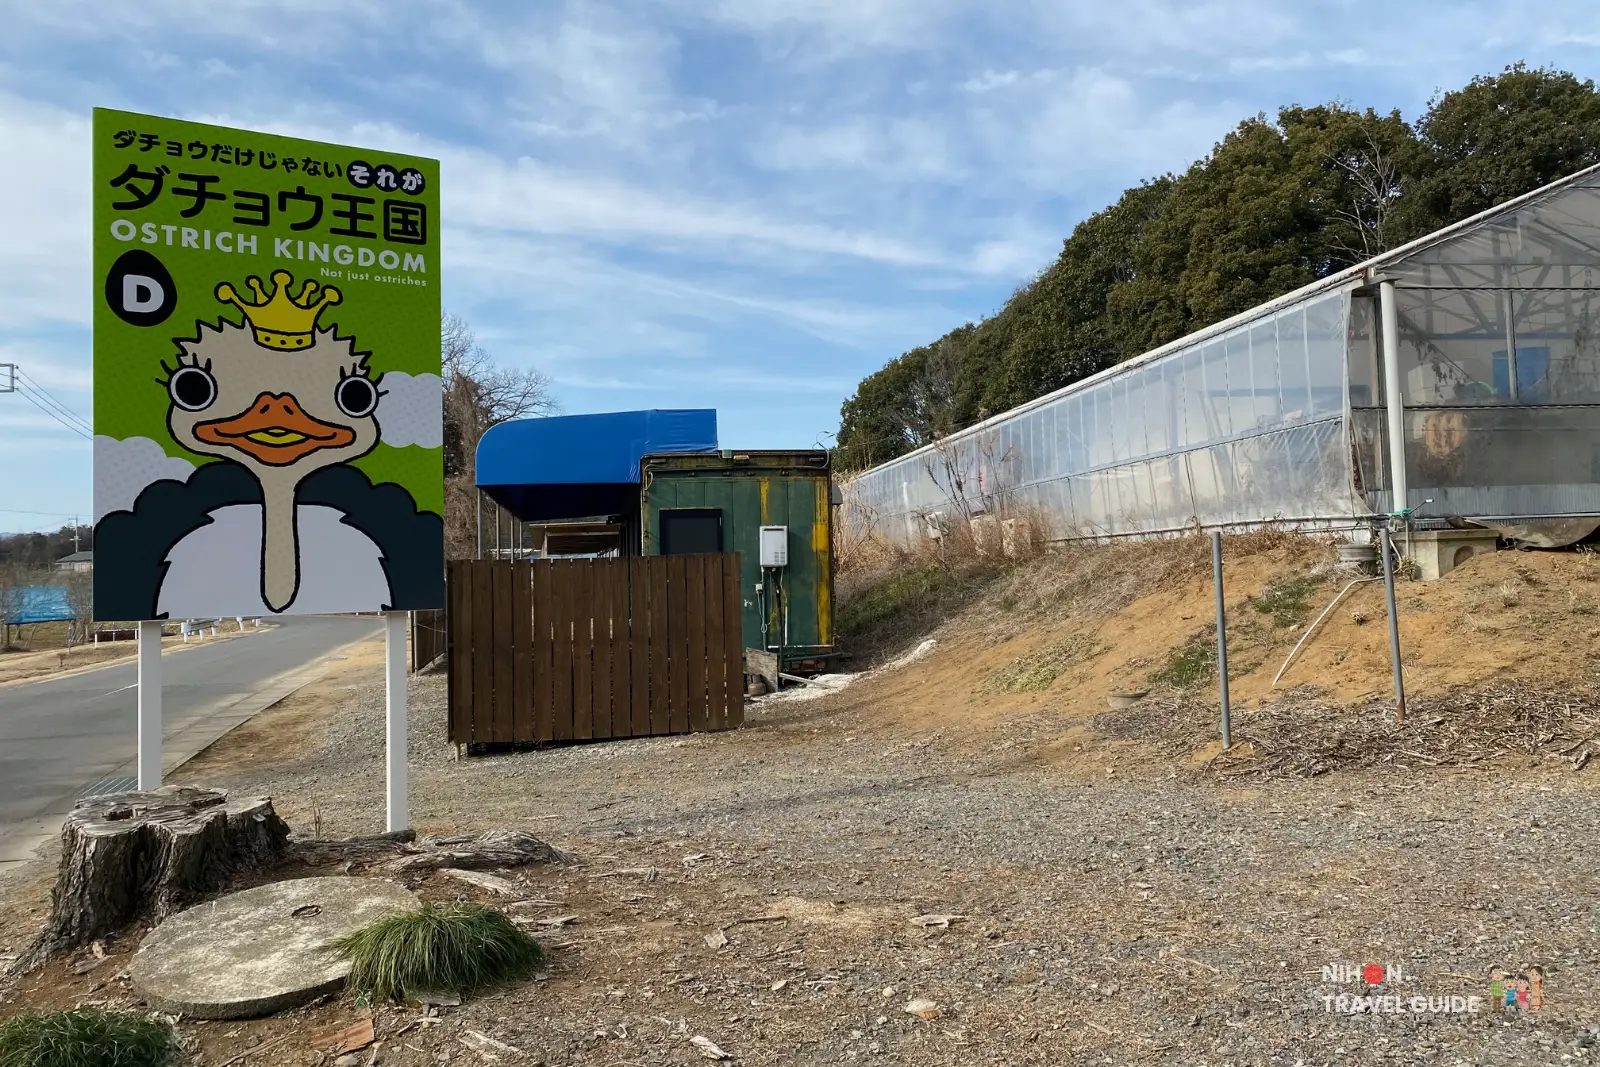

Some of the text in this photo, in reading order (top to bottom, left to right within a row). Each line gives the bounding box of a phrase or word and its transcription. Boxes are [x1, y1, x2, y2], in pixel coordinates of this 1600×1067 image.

[110, 164, 427, 245] ダチョウ王国
[110, 219, 426, 273] OSTRICH KINGDOM
[122, 274, 165, 313] D
[320, 267, 427, 287] Not just ostriches
